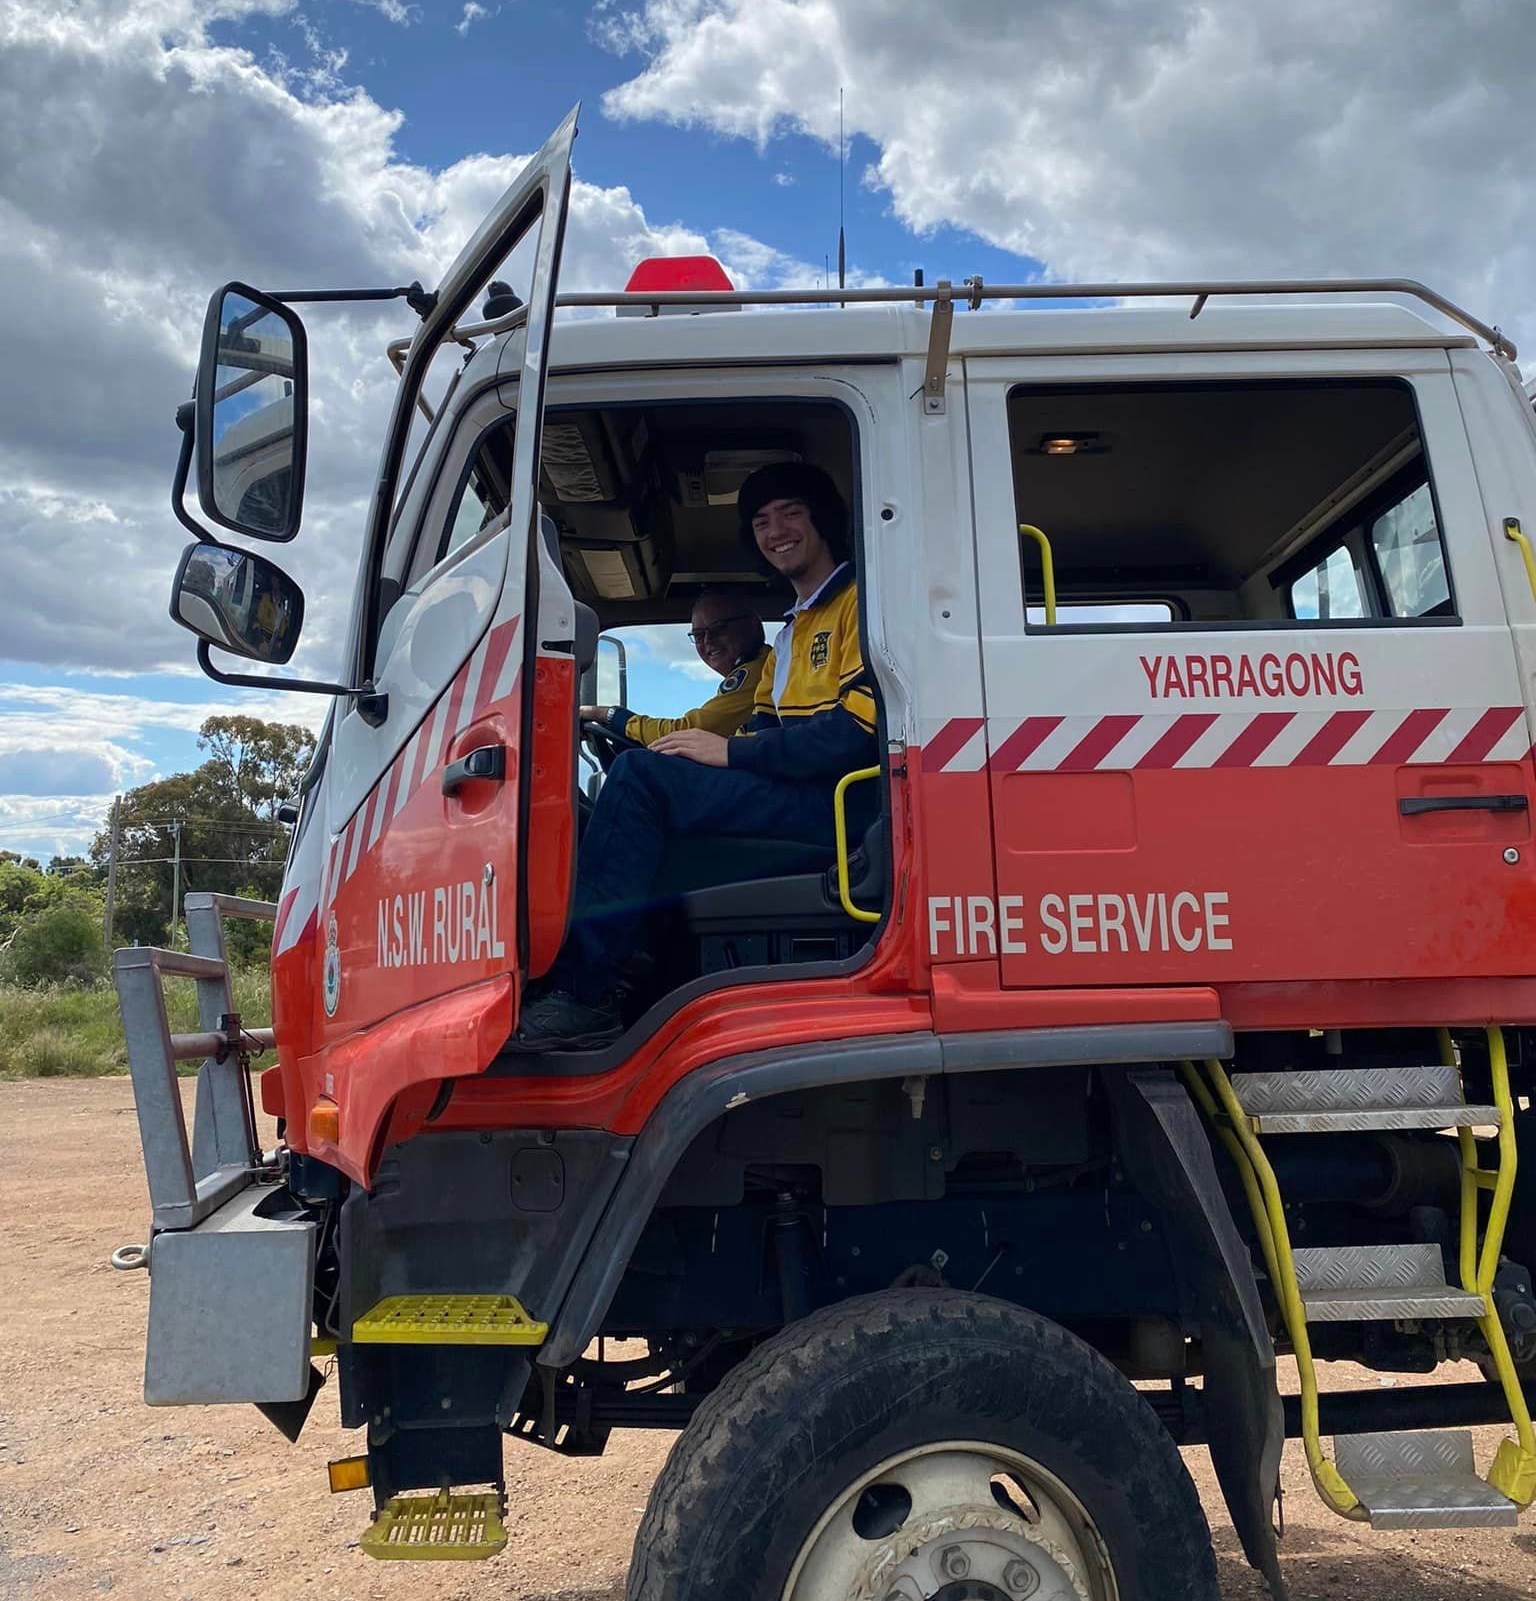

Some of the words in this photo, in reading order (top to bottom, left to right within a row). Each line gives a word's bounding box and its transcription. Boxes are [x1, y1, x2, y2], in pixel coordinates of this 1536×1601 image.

[1139, 652, 1364, 698] YARRAGONG
[377, 890, 427, 968] N.S.W.
[433, 876, 505, 964] RURAL
[928, 895, 1027, 956] FIRE
[1039, 892, 1233, 955] SERVICE
